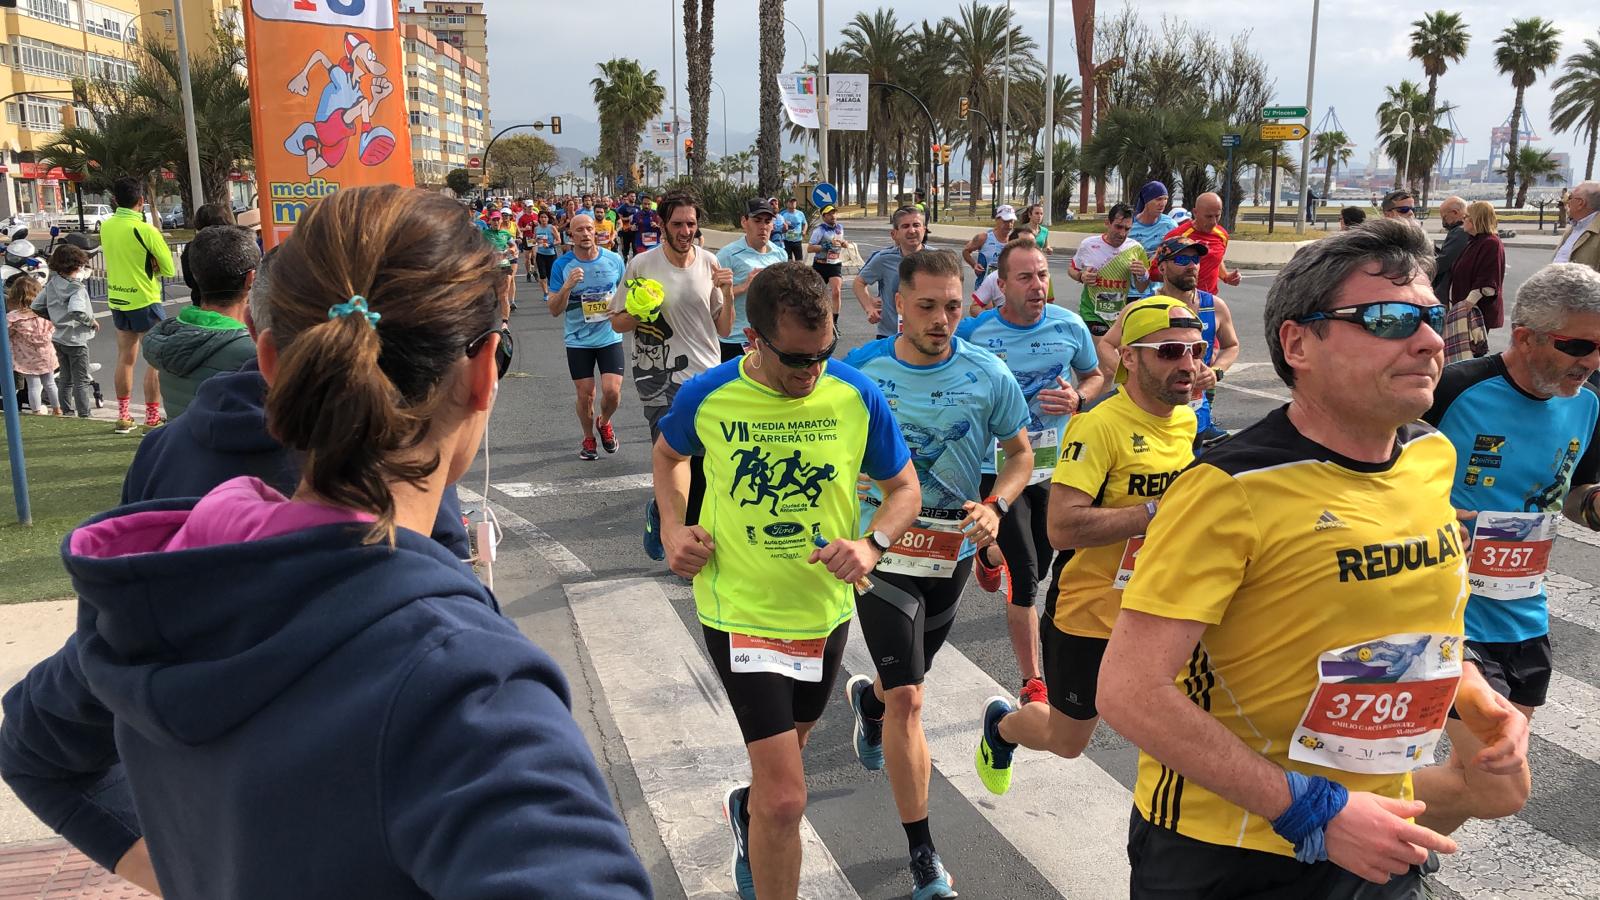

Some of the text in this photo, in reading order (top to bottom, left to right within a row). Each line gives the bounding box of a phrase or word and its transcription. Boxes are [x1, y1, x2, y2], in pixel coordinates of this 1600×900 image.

[588, 303, 607, 311] 7570
[719, 418, 837, 442] VII MEDIA MARATÓN
[752, 433, 838, 443] CARRERA 10 kms
[771, 524, 796, 535] Ford
[1481, 546, 1534, 568] 3757
[734, 653, 750, 665] edp
[1326, 691, 1413, 724] 3798
[1332, 721, 1358, 730] EMILIO
